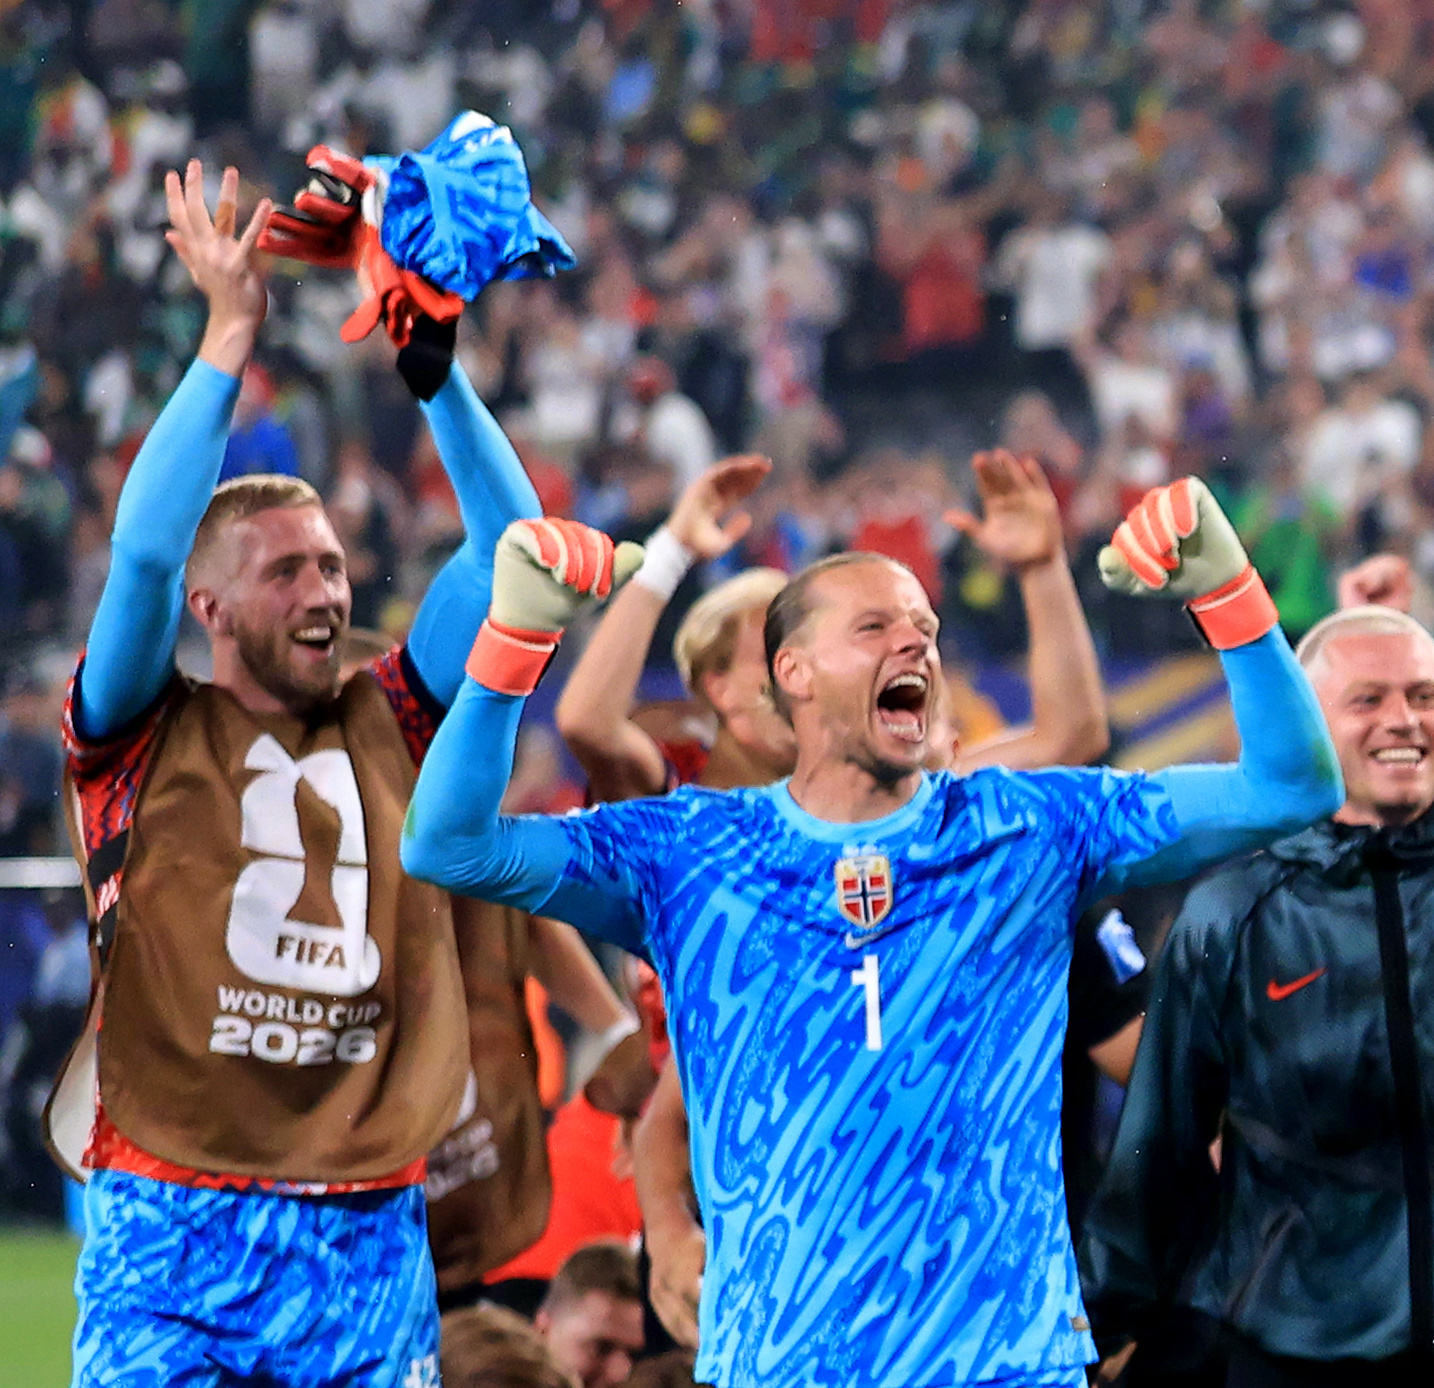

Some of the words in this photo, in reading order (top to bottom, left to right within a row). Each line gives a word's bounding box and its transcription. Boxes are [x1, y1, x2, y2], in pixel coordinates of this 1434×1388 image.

[275, 935, 346, 970] FIFA
[217, 984, 324, 1026] WORLD
[327, 1002, 382, 1029] CUP
[851, 954, 882, 1051] 1
[208, 1014, 378, 1066] 2026
